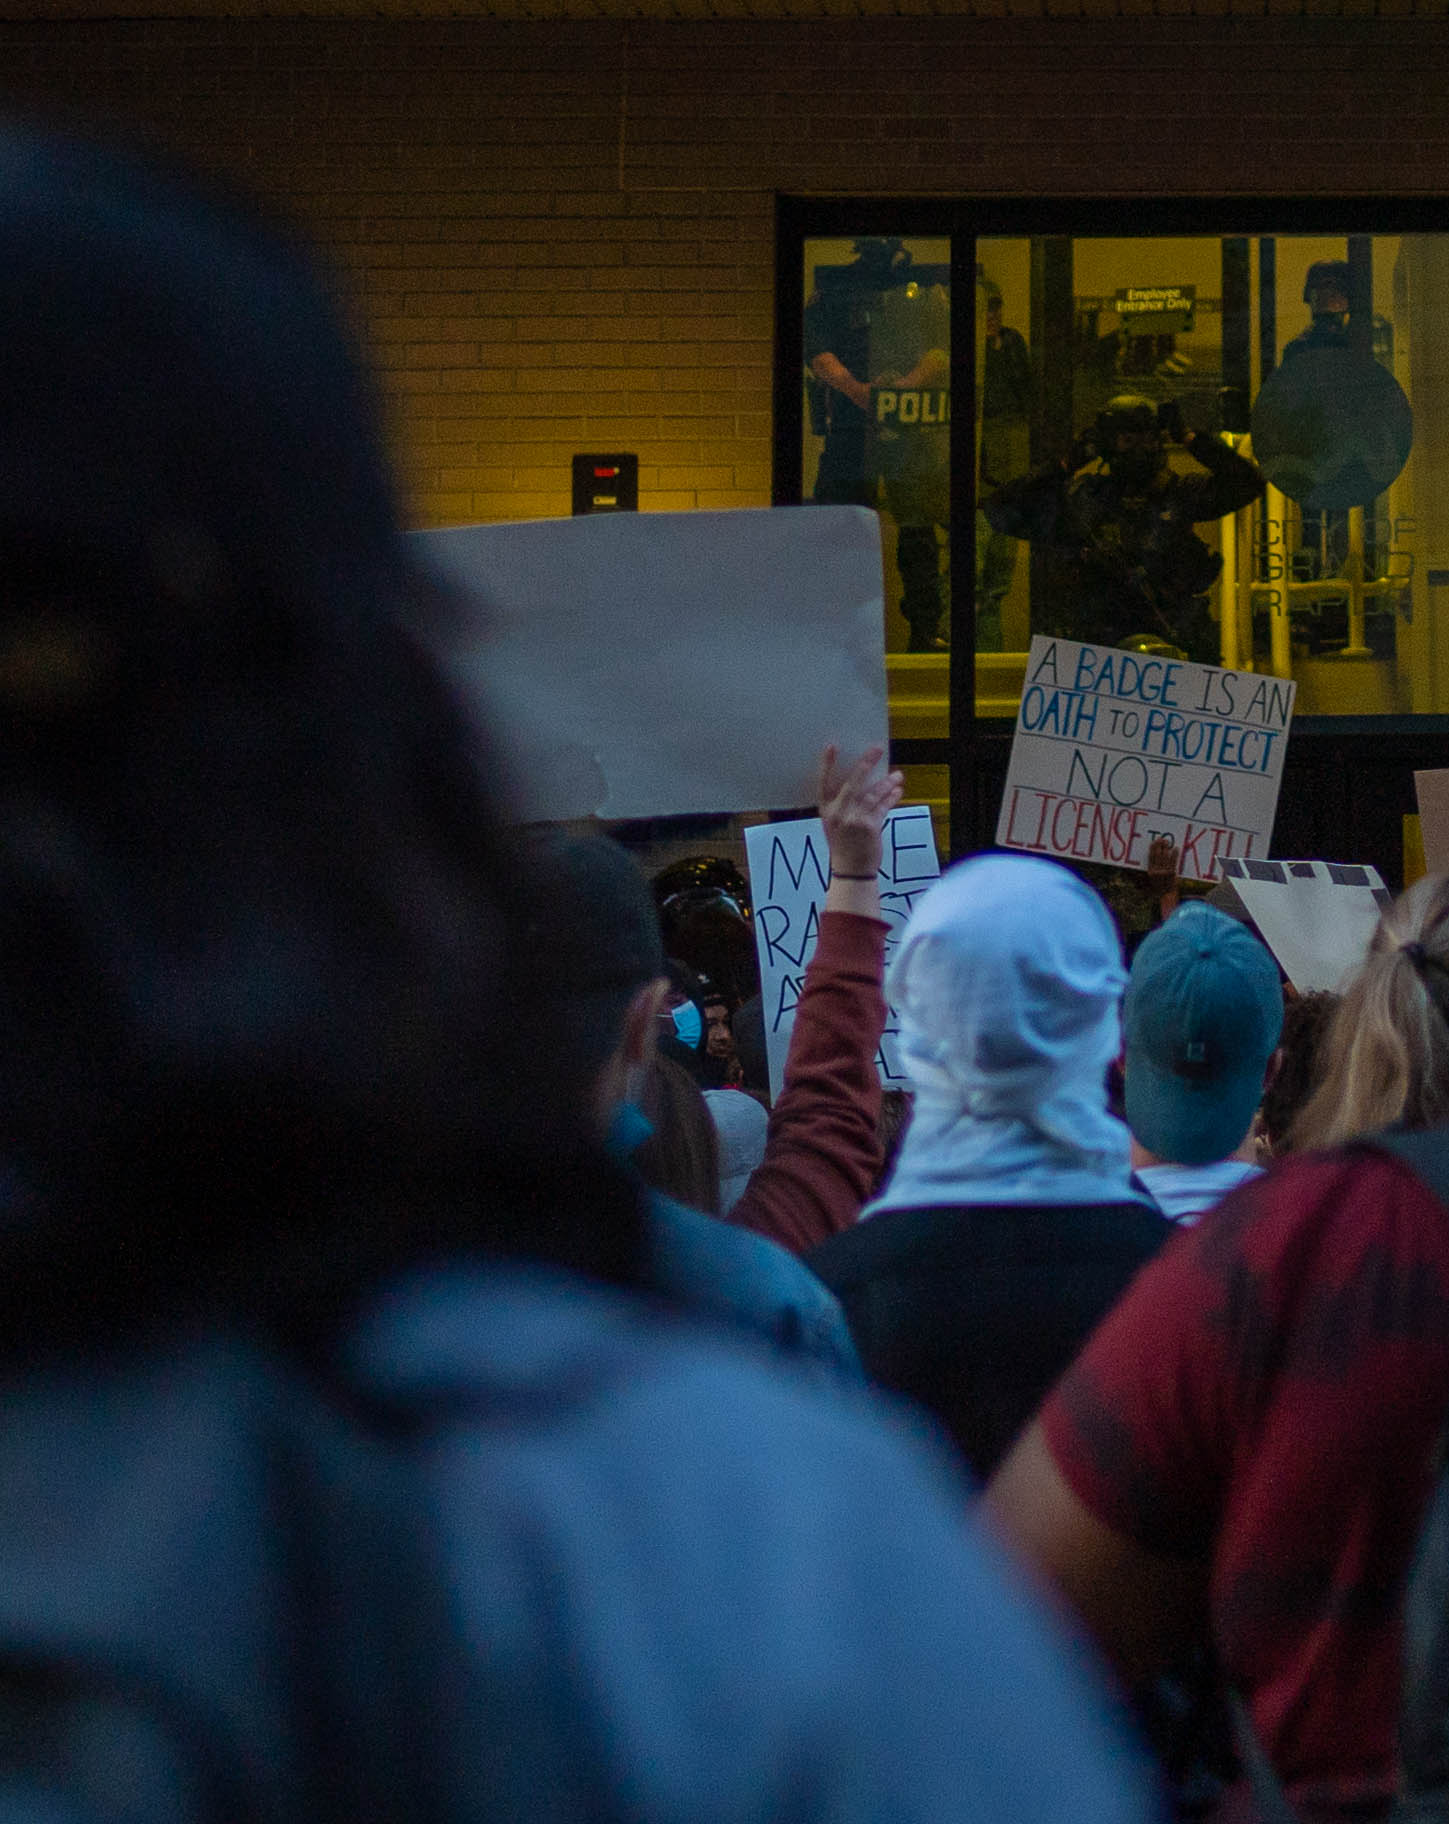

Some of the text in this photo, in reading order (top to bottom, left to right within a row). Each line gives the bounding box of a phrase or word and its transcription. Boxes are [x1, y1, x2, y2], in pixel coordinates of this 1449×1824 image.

[876, 390, 951, 424] POLI
[1032, 641, 1292, 727] A BADGE IS AN
[1021, 685, 1283, 773] OATH TO PROTECT
[1067, 748, 1229, 825] NOT A
[768, 814, 942, 900] ME
[1004, 789, 1150, 867] LICENSE
